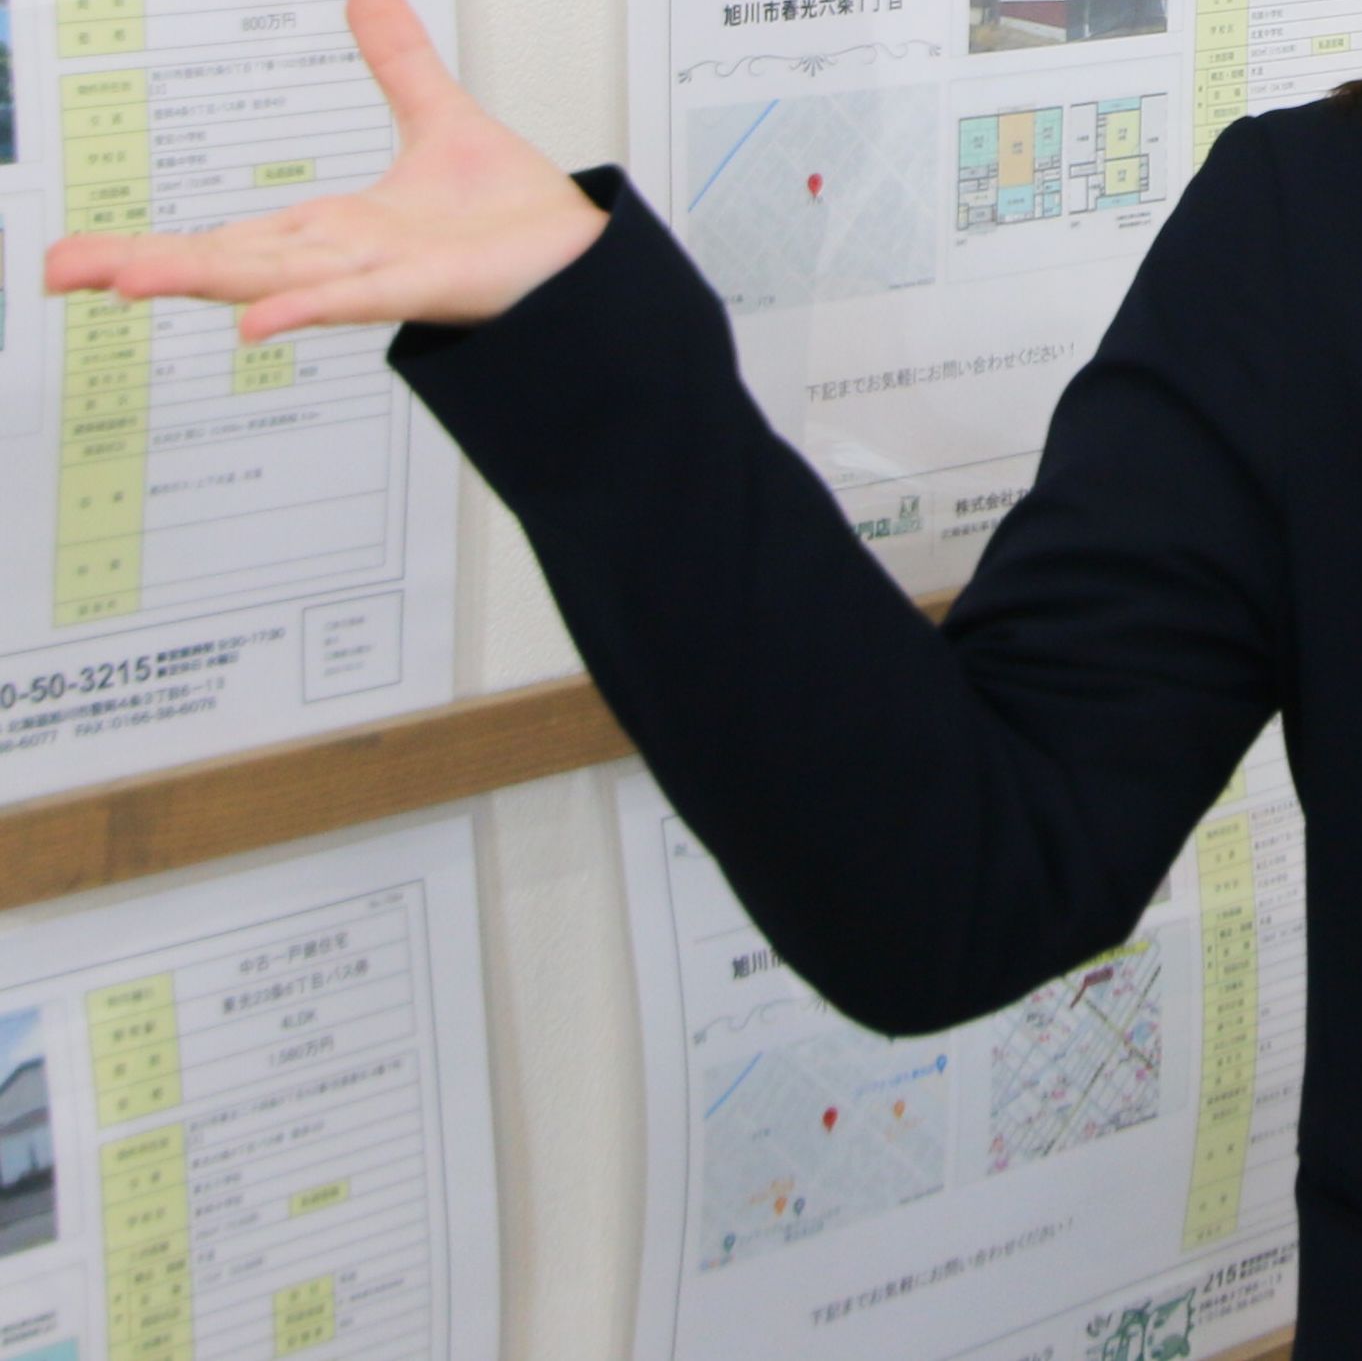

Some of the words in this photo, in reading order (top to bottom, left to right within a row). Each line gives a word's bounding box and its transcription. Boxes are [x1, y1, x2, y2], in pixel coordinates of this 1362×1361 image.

[241, 12, 297, 32] 800万円
[805, 342, 1076, 403] 下記までお気軽にお問い合わせください！
